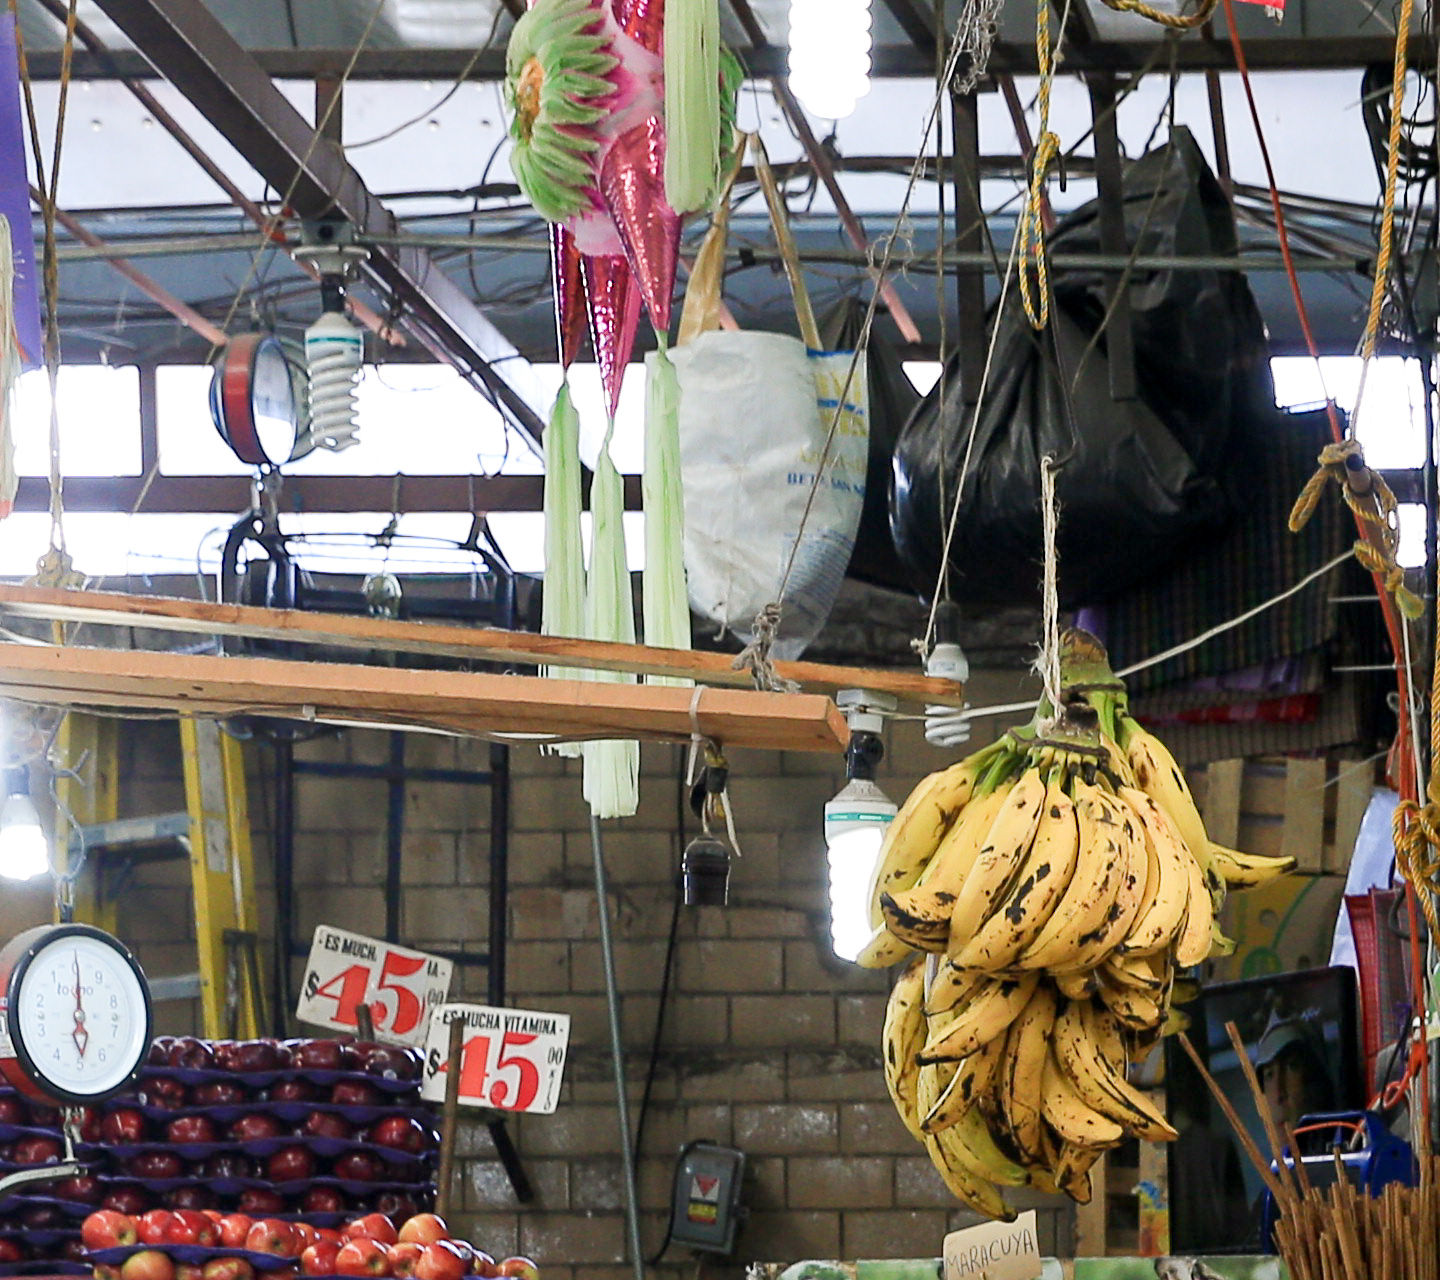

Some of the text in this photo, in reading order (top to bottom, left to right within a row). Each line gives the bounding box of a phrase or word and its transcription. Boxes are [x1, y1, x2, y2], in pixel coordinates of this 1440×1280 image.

[325, 933, 378, 963] ES MUCH
[462, 1010, 501, 1030] MUCHA
[504, 1015, 558, 1035] VITAMINA
[943, 1228, 1035, 1277] MARACUYA
